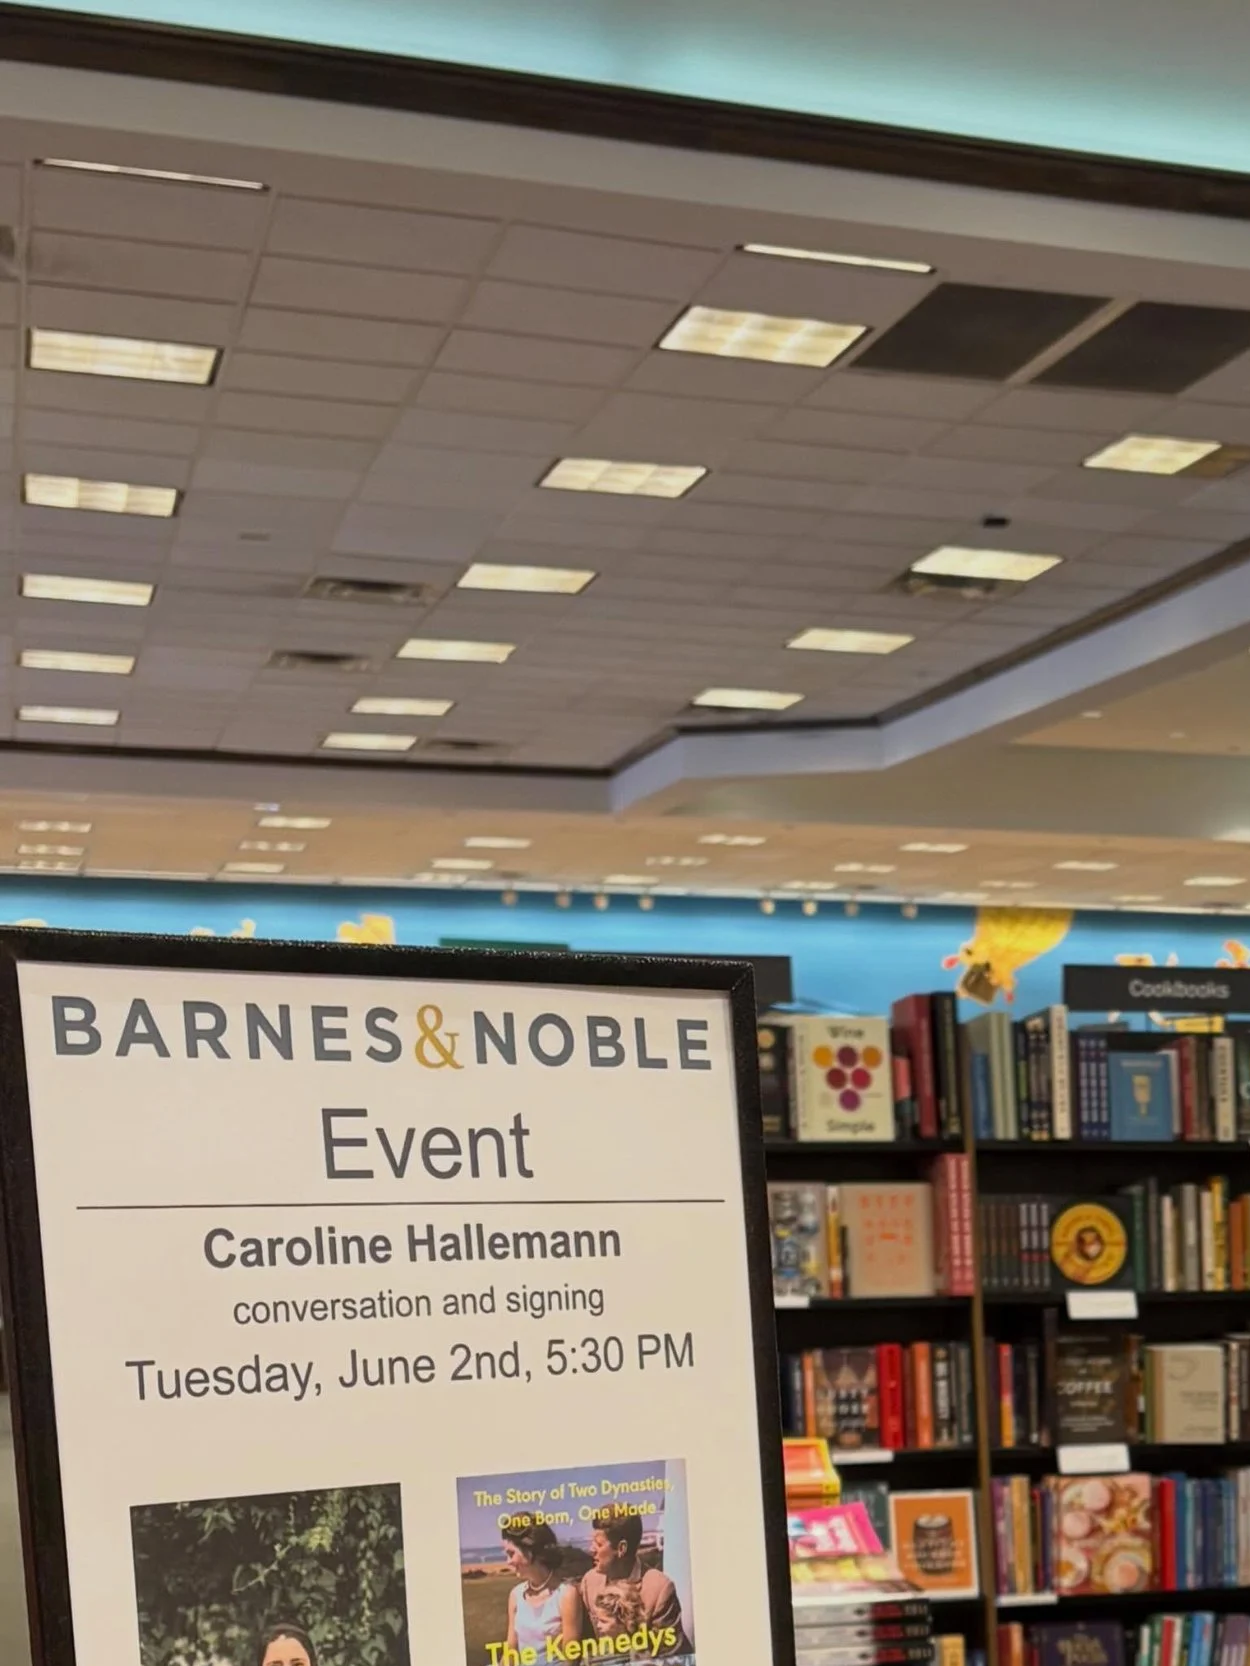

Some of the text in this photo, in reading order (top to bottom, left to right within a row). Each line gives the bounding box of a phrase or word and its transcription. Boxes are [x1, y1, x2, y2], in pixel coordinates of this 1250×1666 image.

[1128, 979, 1229, 999] Cookbooks
[827, 1026, 865, 1038] Wine
[322, 1108, 534, 1179] Event
[827, 1119, 876, 1134] Simple
[204, 1223, 621, 1269] Caroline Hallemann
[234, 1285, 604, 1325] conversation and signing
[125, 1332, 694, 1401] Tuesday, June 2nd, 5:30 PM
[474, 1475, 675, 1511] The Story of Two Dynasties,
[498, 1500, 657, 1529] One Born, One Made
[546, 1623, 678, 1663] Kennedys
